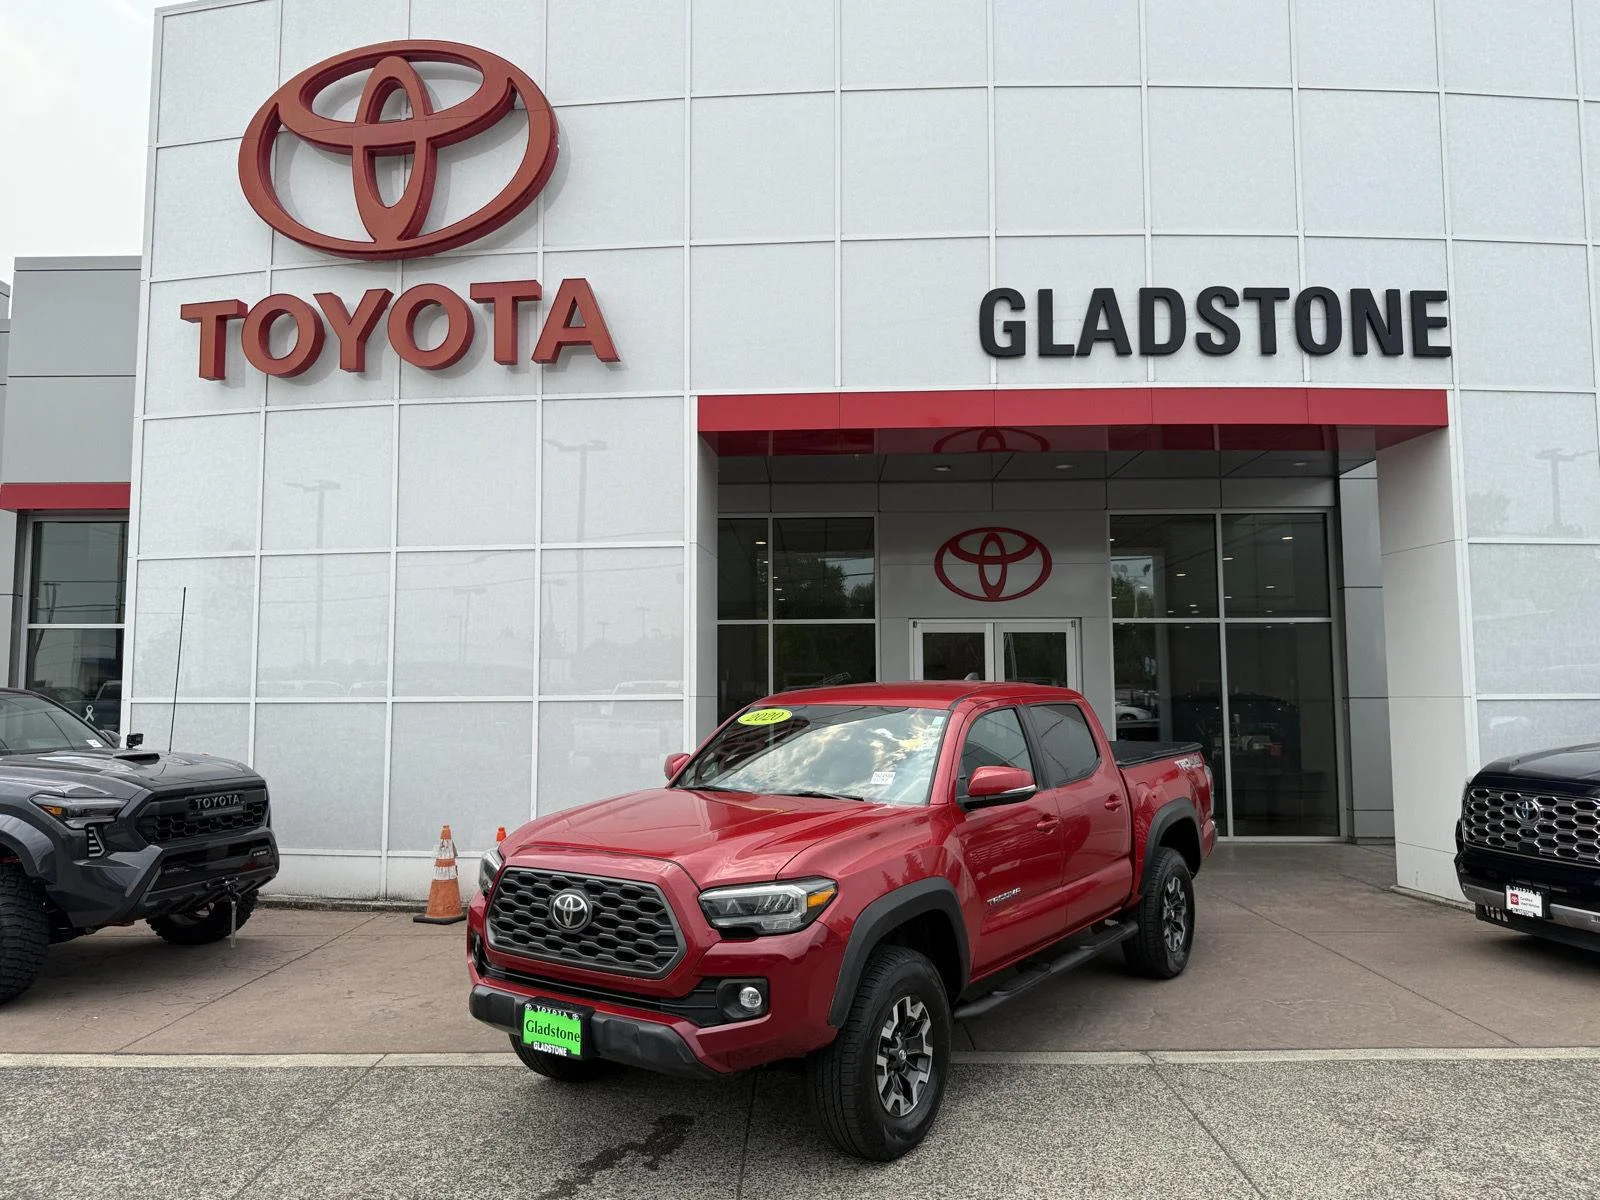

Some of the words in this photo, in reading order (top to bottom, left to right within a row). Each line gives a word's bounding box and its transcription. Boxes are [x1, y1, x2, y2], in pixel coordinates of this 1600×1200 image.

[180, 278, 620, 380] TOYOTA
[979, 286, 1451, 357] GLADSTONE
[745, 712, 785, 722] 2020
[195, 794, 240, 809] TOYOTA
[536, 1005, 568, 1018] TOYOTA
[525, 1019, 581, 1043] Gladstone
[533, 1041, 568, 1057] GLADSTONE
